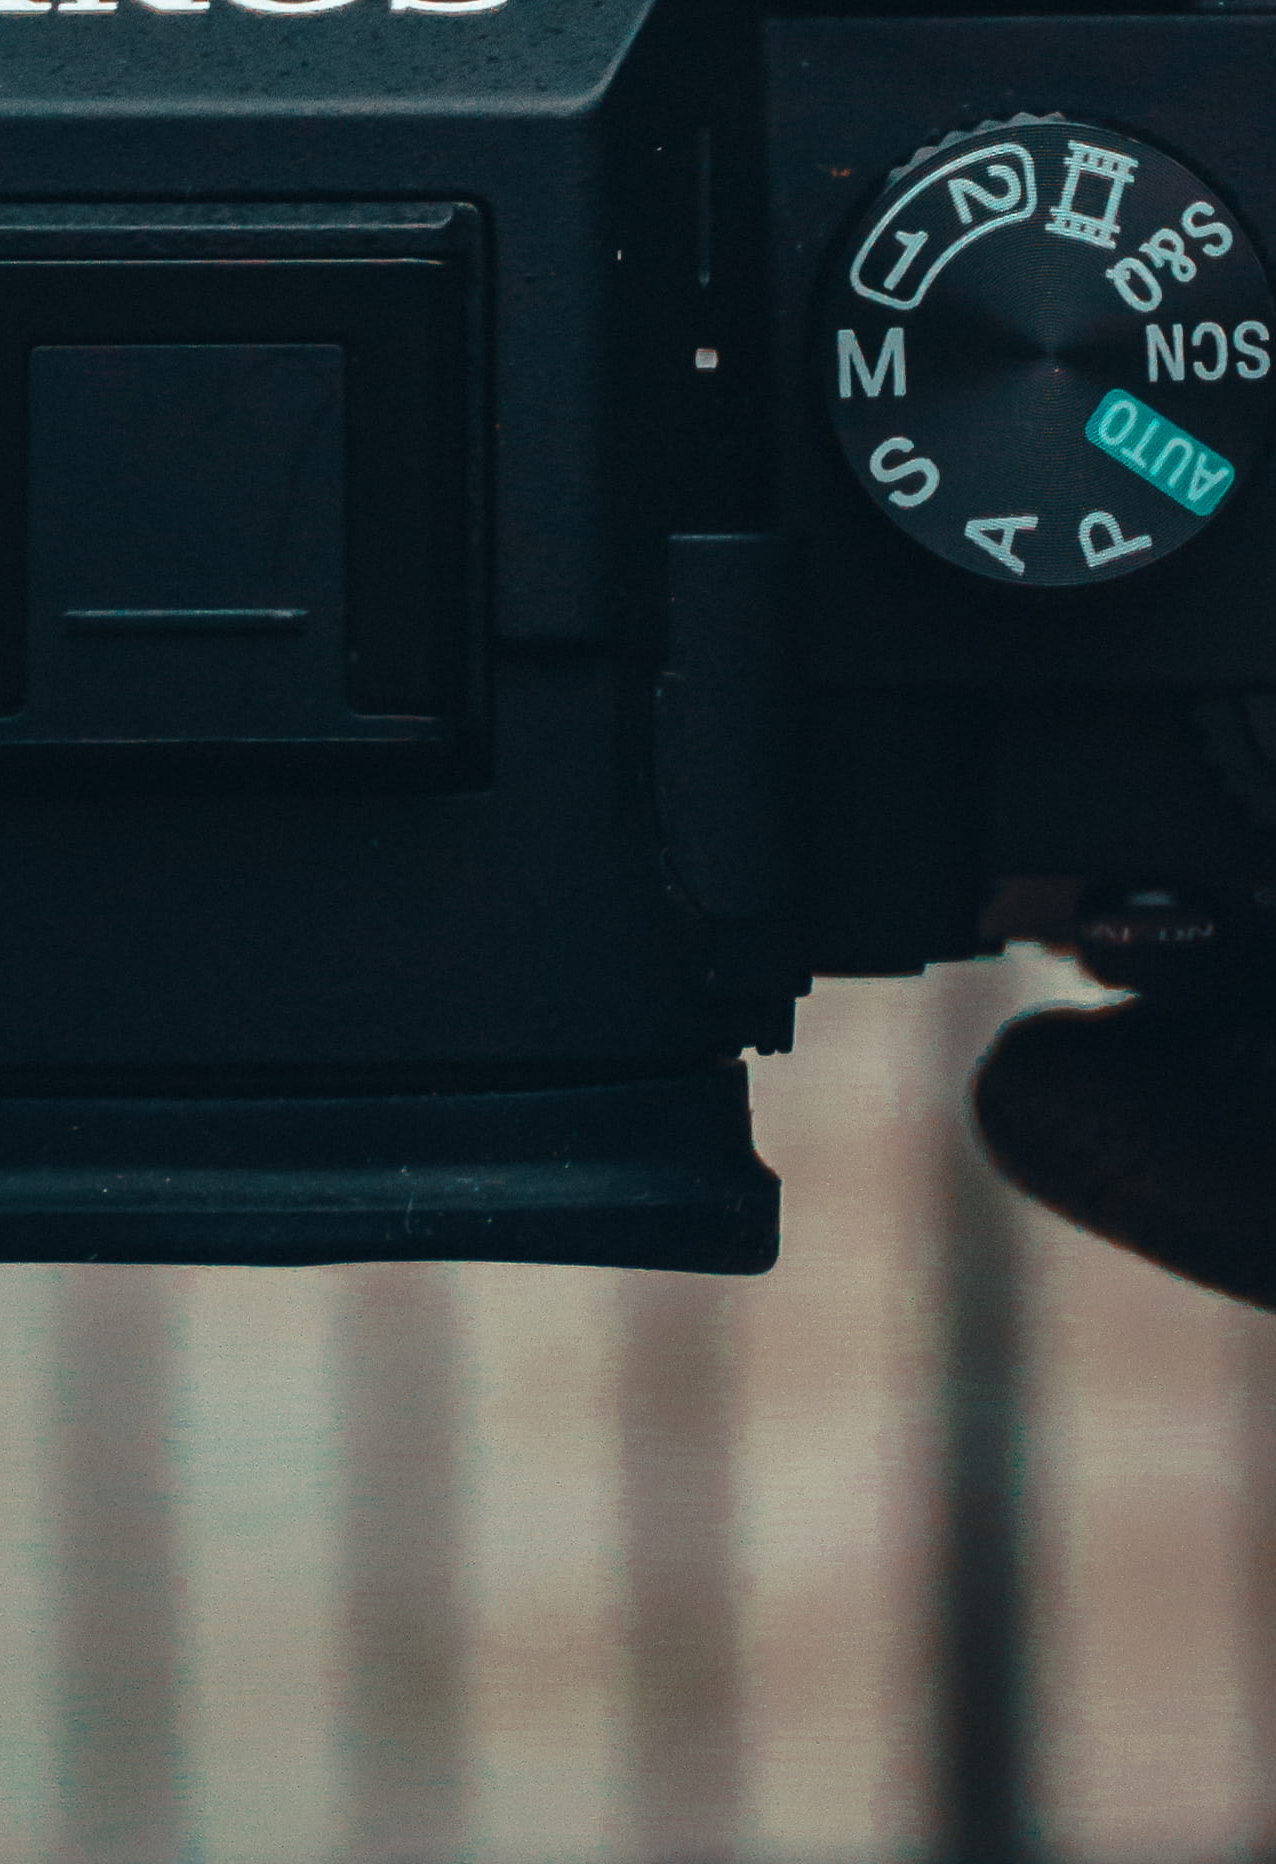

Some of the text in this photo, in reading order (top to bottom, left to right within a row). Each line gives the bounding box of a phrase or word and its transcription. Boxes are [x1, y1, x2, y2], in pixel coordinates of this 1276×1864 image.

[947, 163, 1023, 225] 2
[882, 229, 929, 292] 1
[1105, 200, 1234, 313] S&Q
[836, 325, 908, 400] M
[1144, 318, 1272, 384] SCN
[868, 434, 942, 511] S
[1098, 398, 1230, 503] AUTO
[963, 512, 1041, 577] A
[1076, 508, 1155, 570] P
